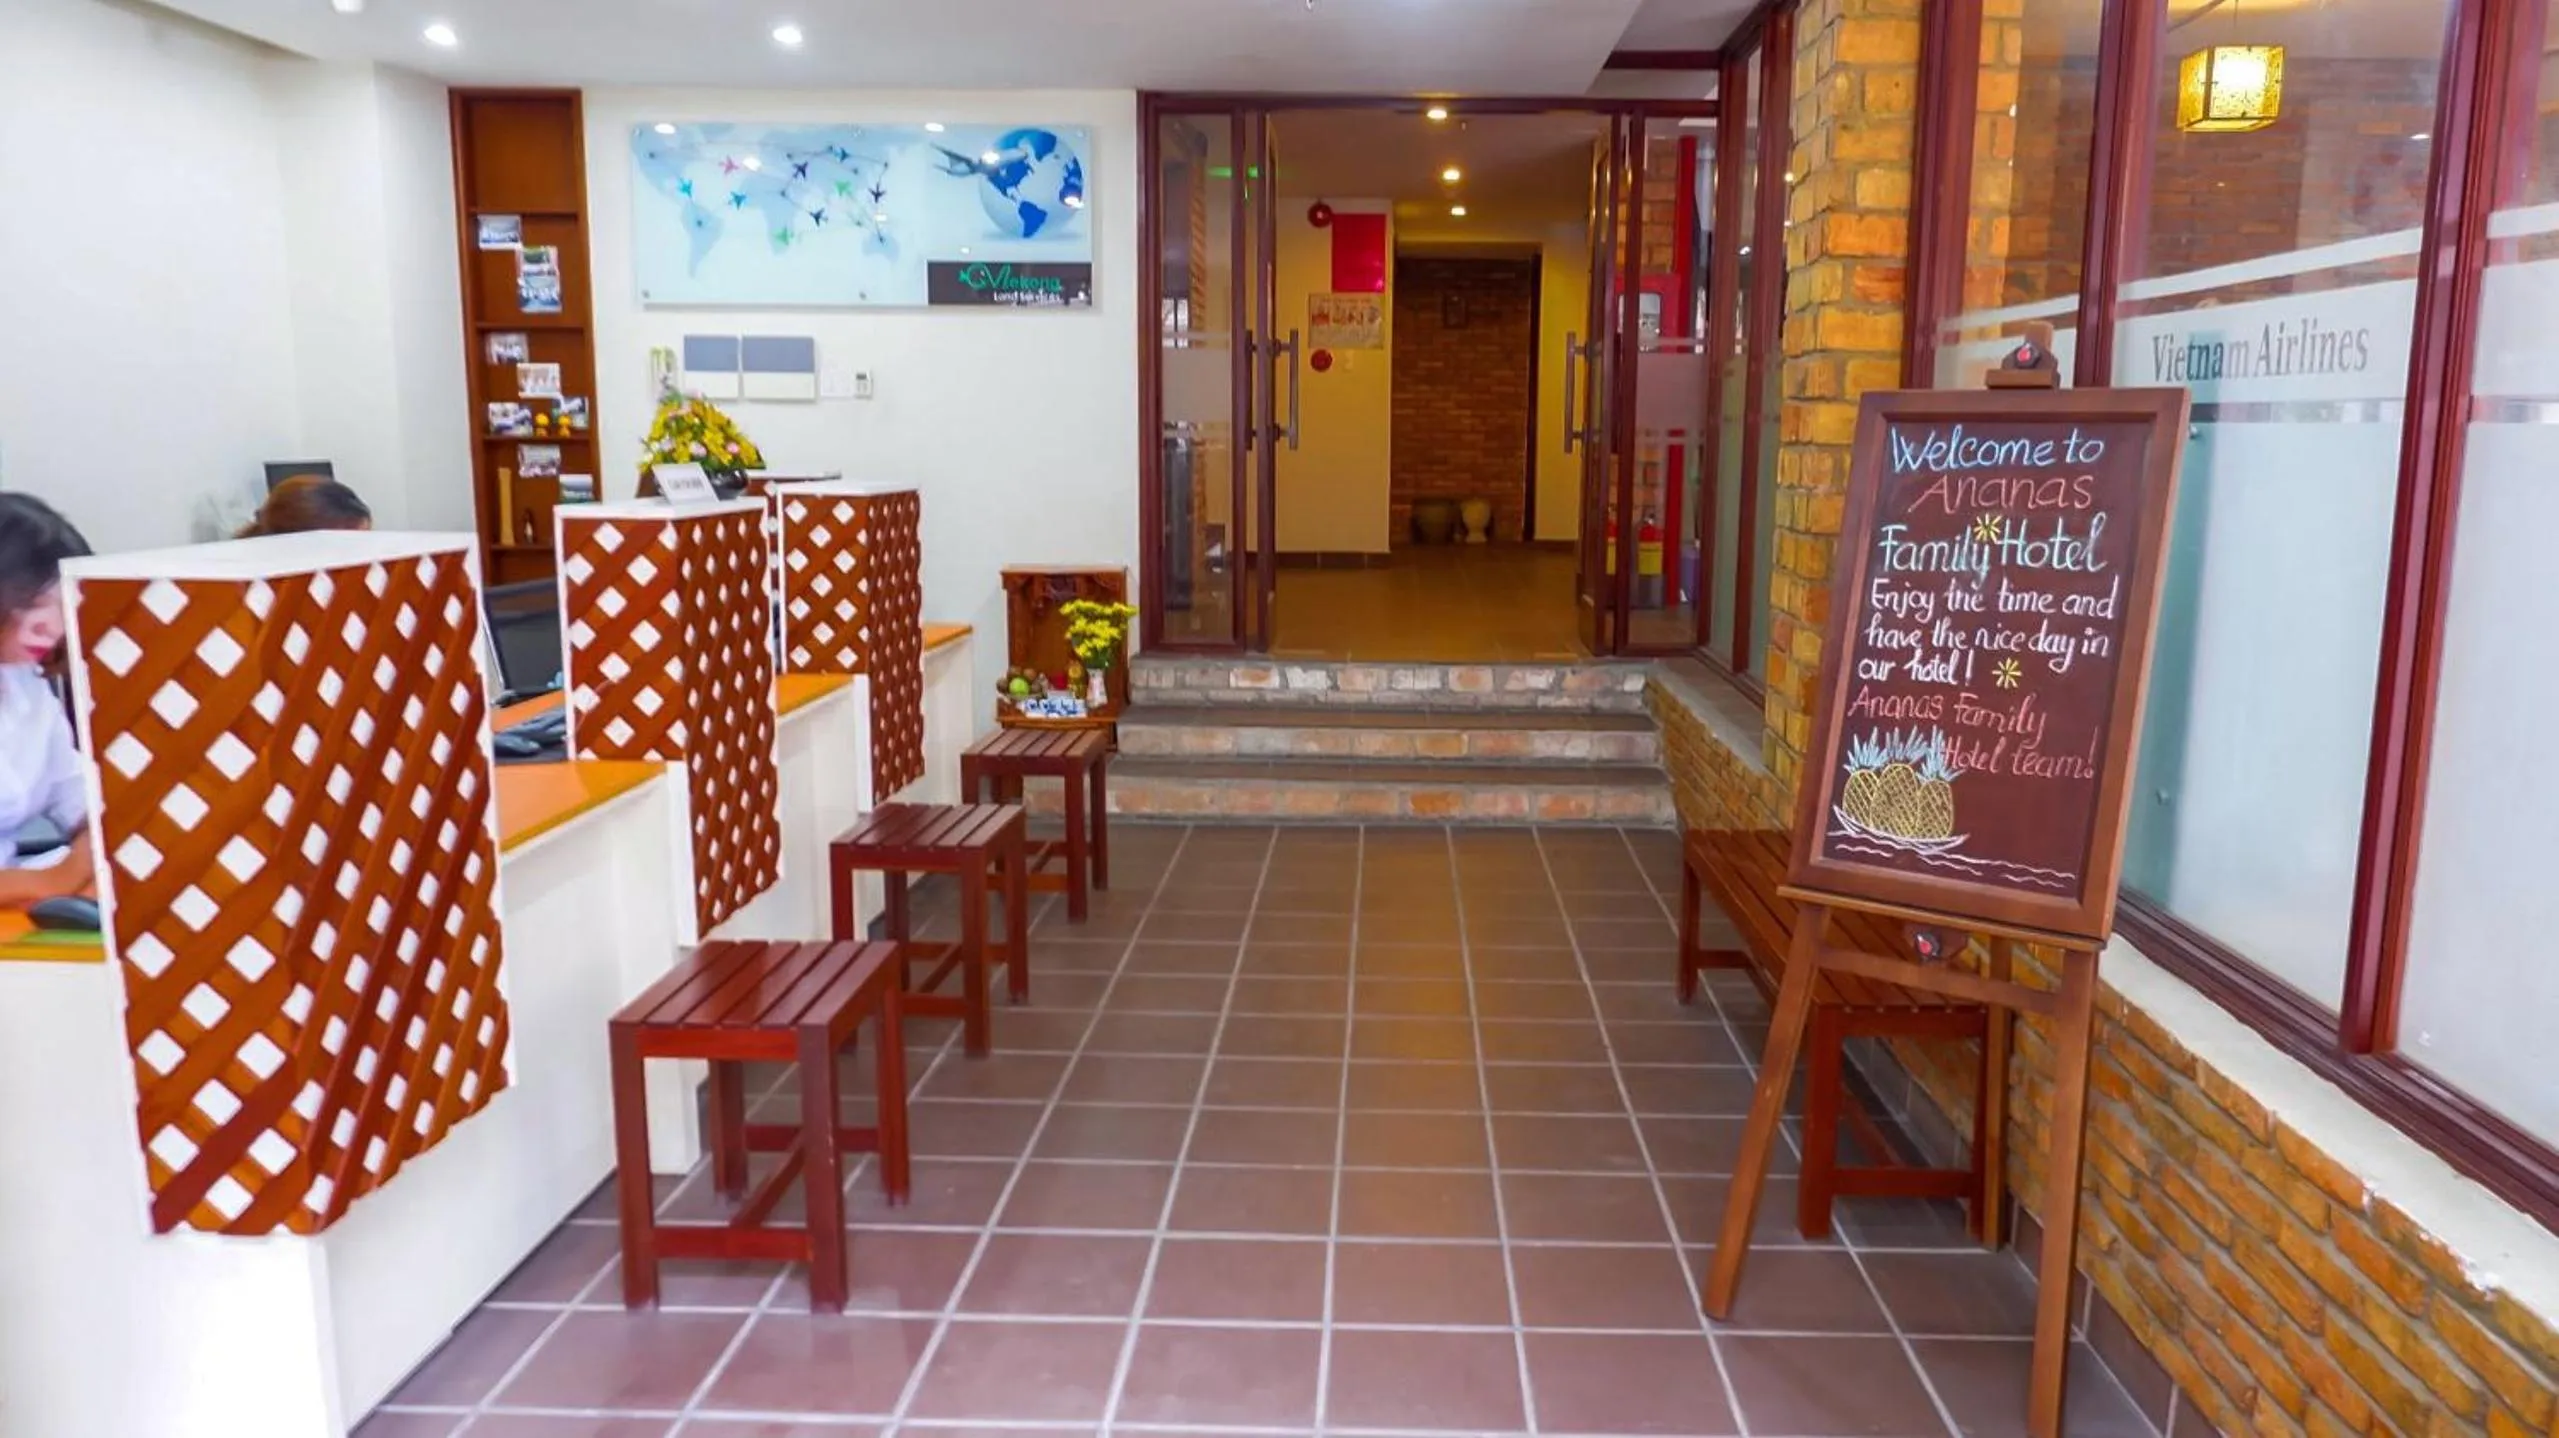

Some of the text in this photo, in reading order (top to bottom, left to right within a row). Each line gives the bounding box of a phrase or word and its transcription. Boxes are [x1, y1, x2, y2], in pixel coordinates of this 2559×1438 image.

[2152, 317, 2370, 382] Vietnam Airlines
[1891, 424, 2105, 473] Welcome to
[1907, 473, 2095, 515] Ananas
[1878, 512, 2108, 587] Family Hotel
[1871, 574, 2120, 624] Enjoy the time and
[1864, 612, 2109, 674] have the nice day in
[1858, 657, 1896, 682] our
[1847, 684, 2047, 749] Ananas Family
[1943, 727, 2098, 779] Hotel team!
